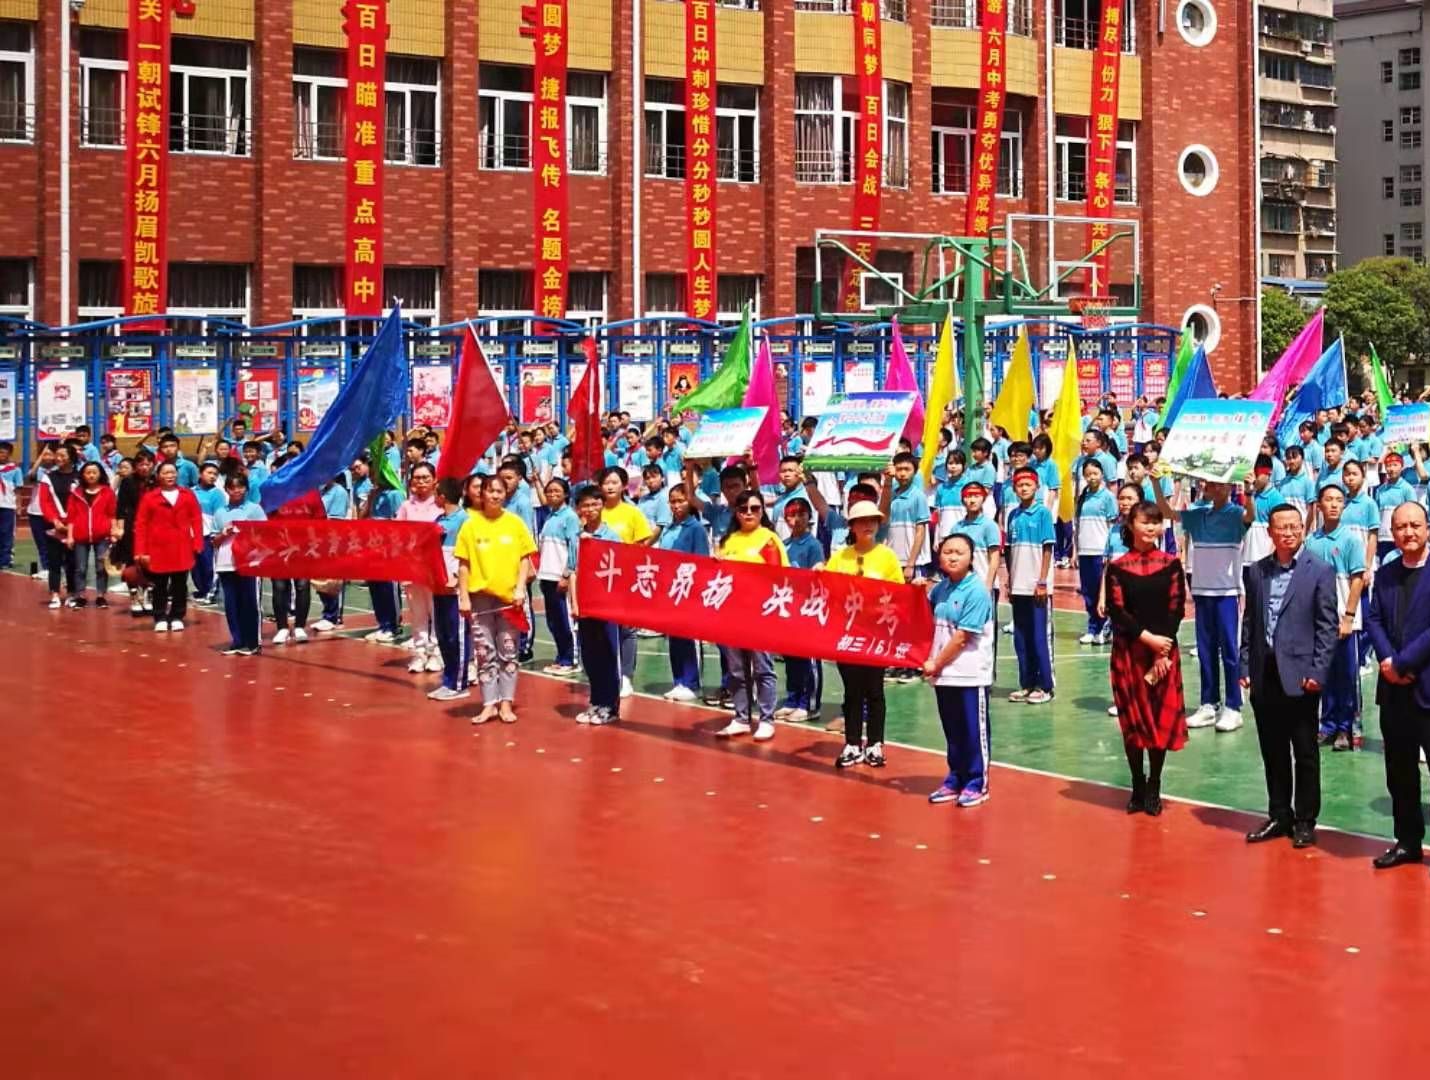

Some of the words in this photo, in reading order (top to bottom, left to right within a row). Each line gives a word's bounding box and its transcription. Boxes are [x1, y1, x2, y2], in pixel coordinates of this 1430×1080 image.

[541, 4, 562, 56] 圆梦
[353, 4, 377, 303] 百日瞄准重点高中
[540, 77, 561, 188] 捷报飞传
[691, 1, 712, 318] 百日冲刺珍惜分分秒秒圆人生梦
[862, 95, 879, 195] 百日会战
[969, 28, 1001, 233] 六月中考勇夺优异成绩
[541, 208, 562, 317] 名题金榜
[595, 548, 734, 610] 斗志昂扬
[761, 578, 901, 637] 决战中考
